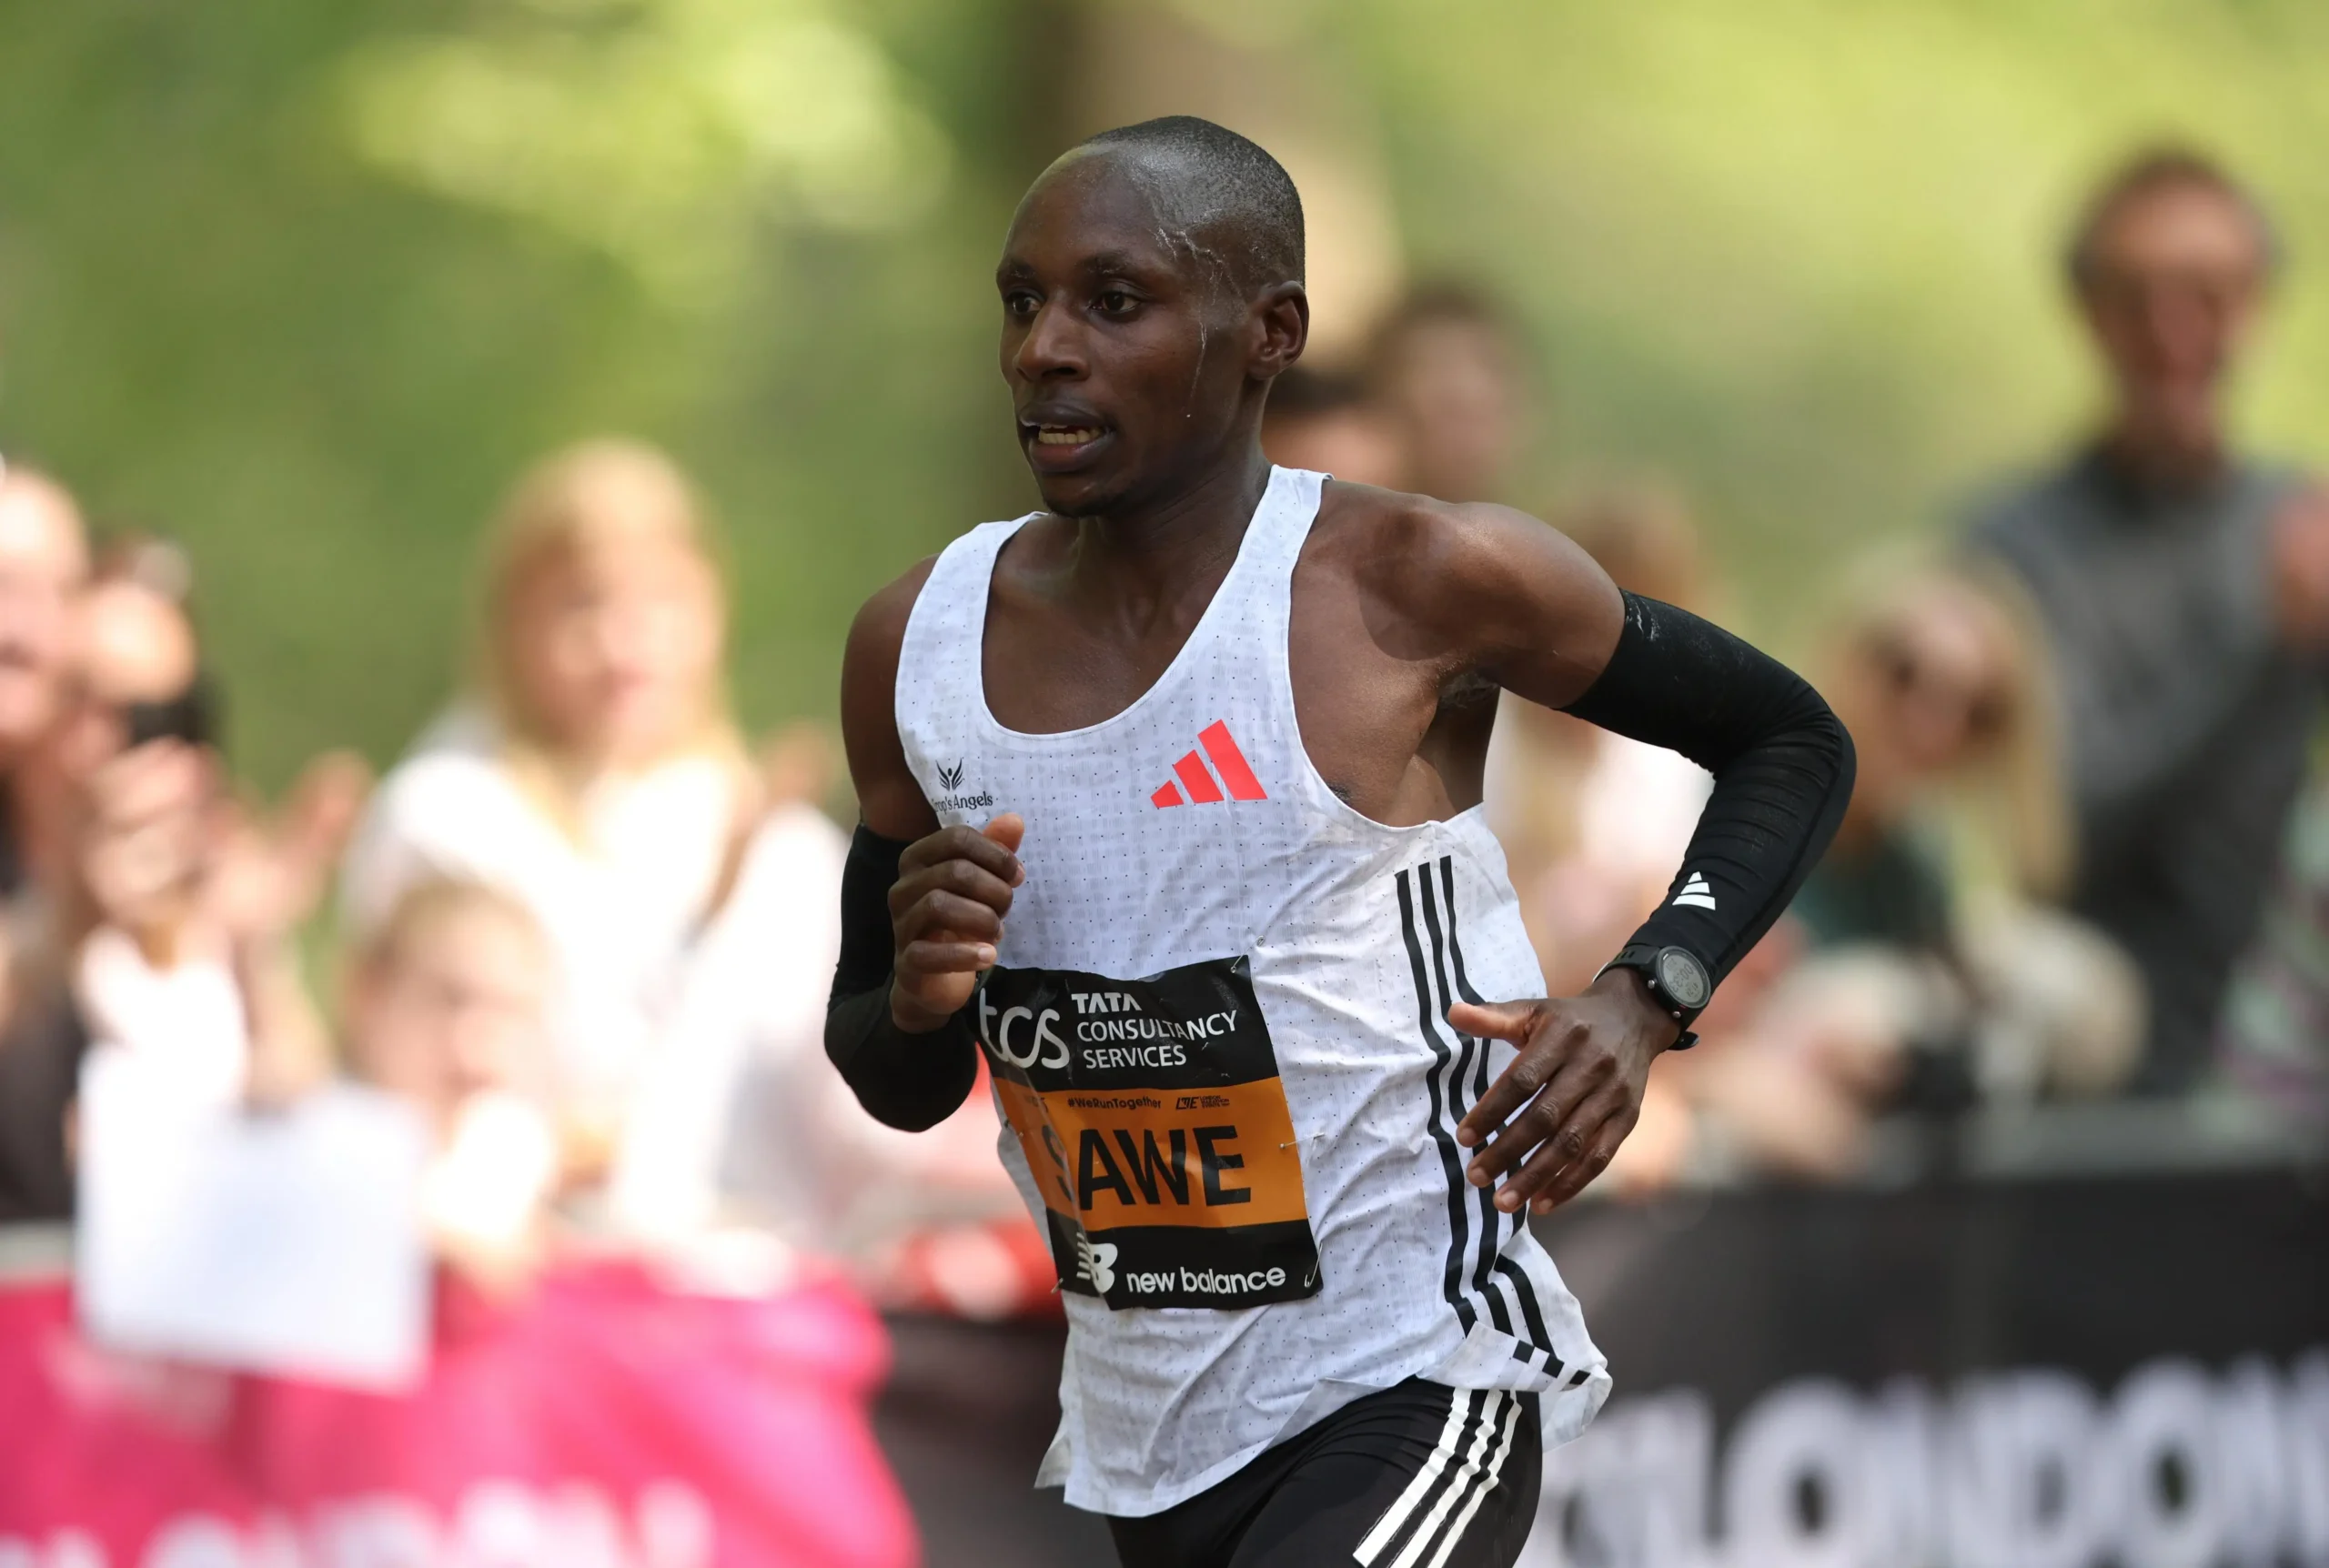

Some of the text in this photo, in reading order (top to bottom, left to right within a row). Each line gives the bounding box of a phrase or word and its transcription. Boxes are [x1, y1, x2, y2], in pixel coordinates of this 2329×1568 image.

[932, 790, 993, 815] rop's Angels
[1071, 991, 1143, 1014] TATA
[1076, 1010, 1237, 1042] CONSULTANCY
[1083, 1045, 1187, 1070] SERVICES
[1067, 1094, 1162, 1111] #WeRunTogether
[1125, 1266, 1286, 1294] new balance
